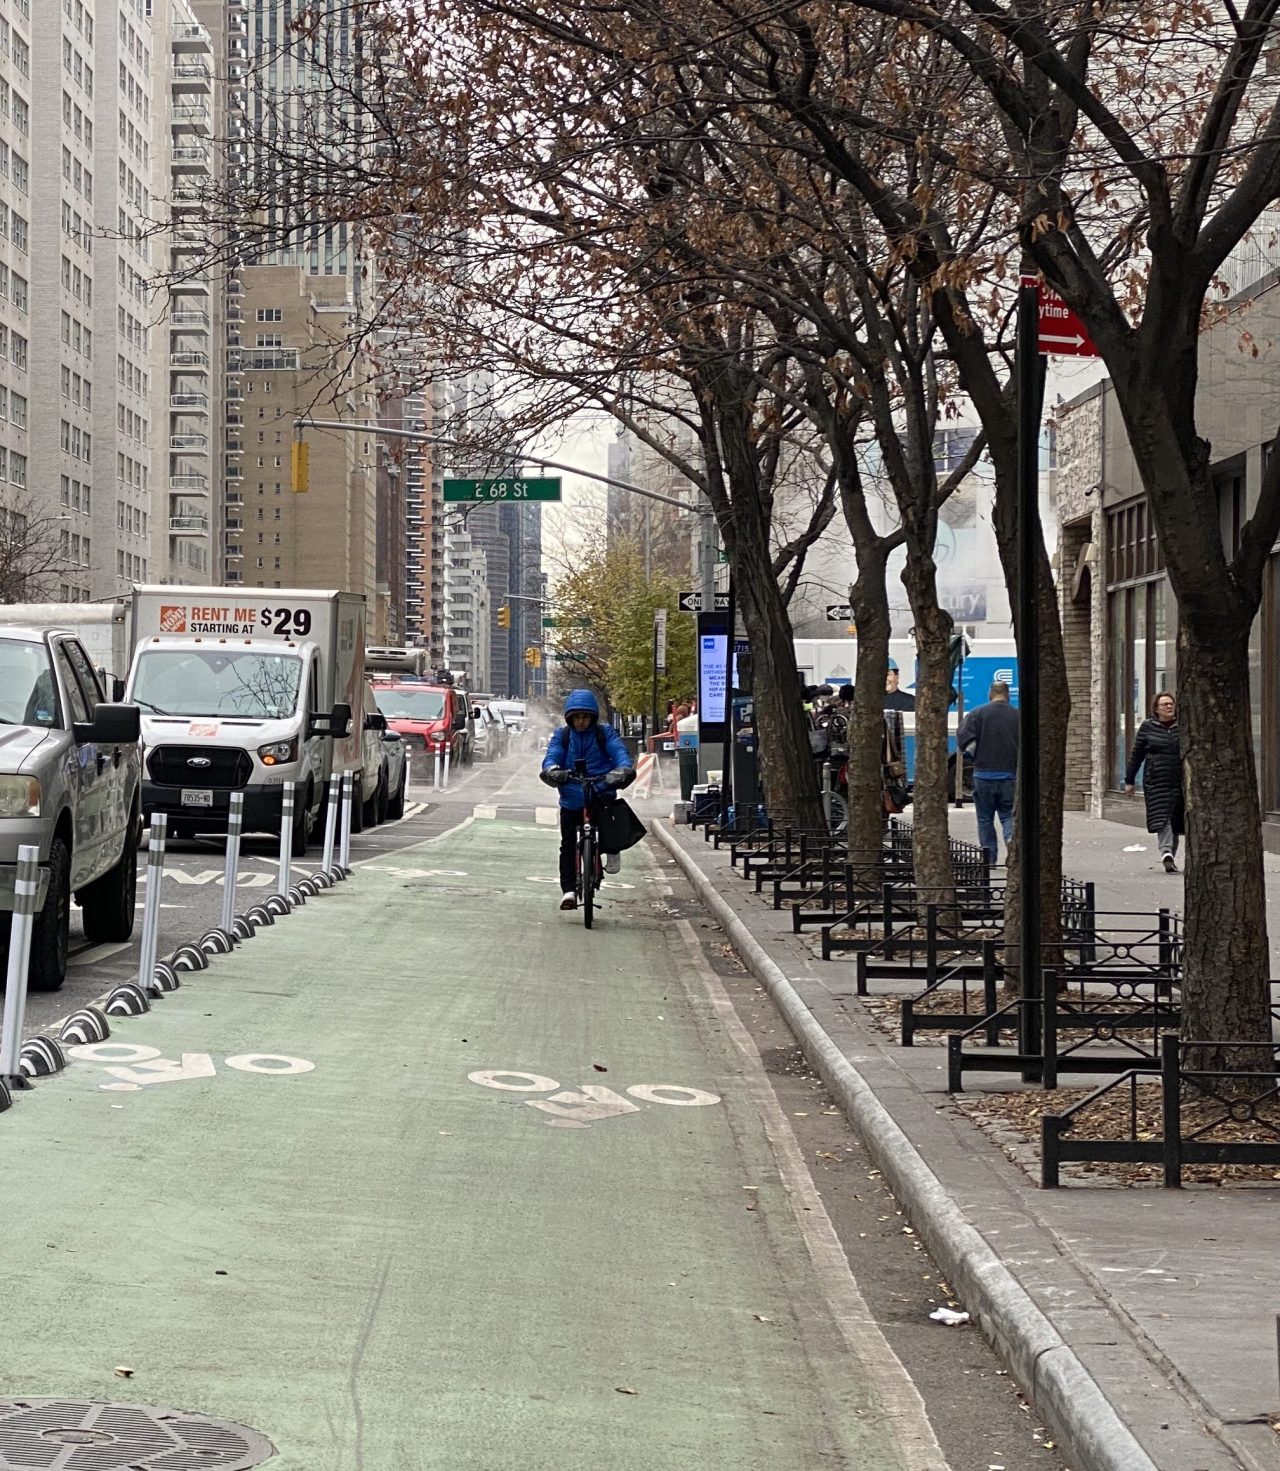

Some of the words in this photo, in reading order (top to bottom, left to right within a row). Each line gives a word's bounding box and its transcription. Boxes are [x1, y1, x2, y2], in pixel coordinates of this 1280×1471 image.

[1038, 303, 1070, 319] ytime
[489, 483, 507, 497] 68
[513, 482, 528, 497] St
[687, 597, 702, 606] ON
[191, 607, 229, 621] RENT
[234, 608, 256, 622] ME
[261, 608, 312, 636] $29
[190, 623, 238, 634] STARTING
[242, 624, 255, 634] AT
